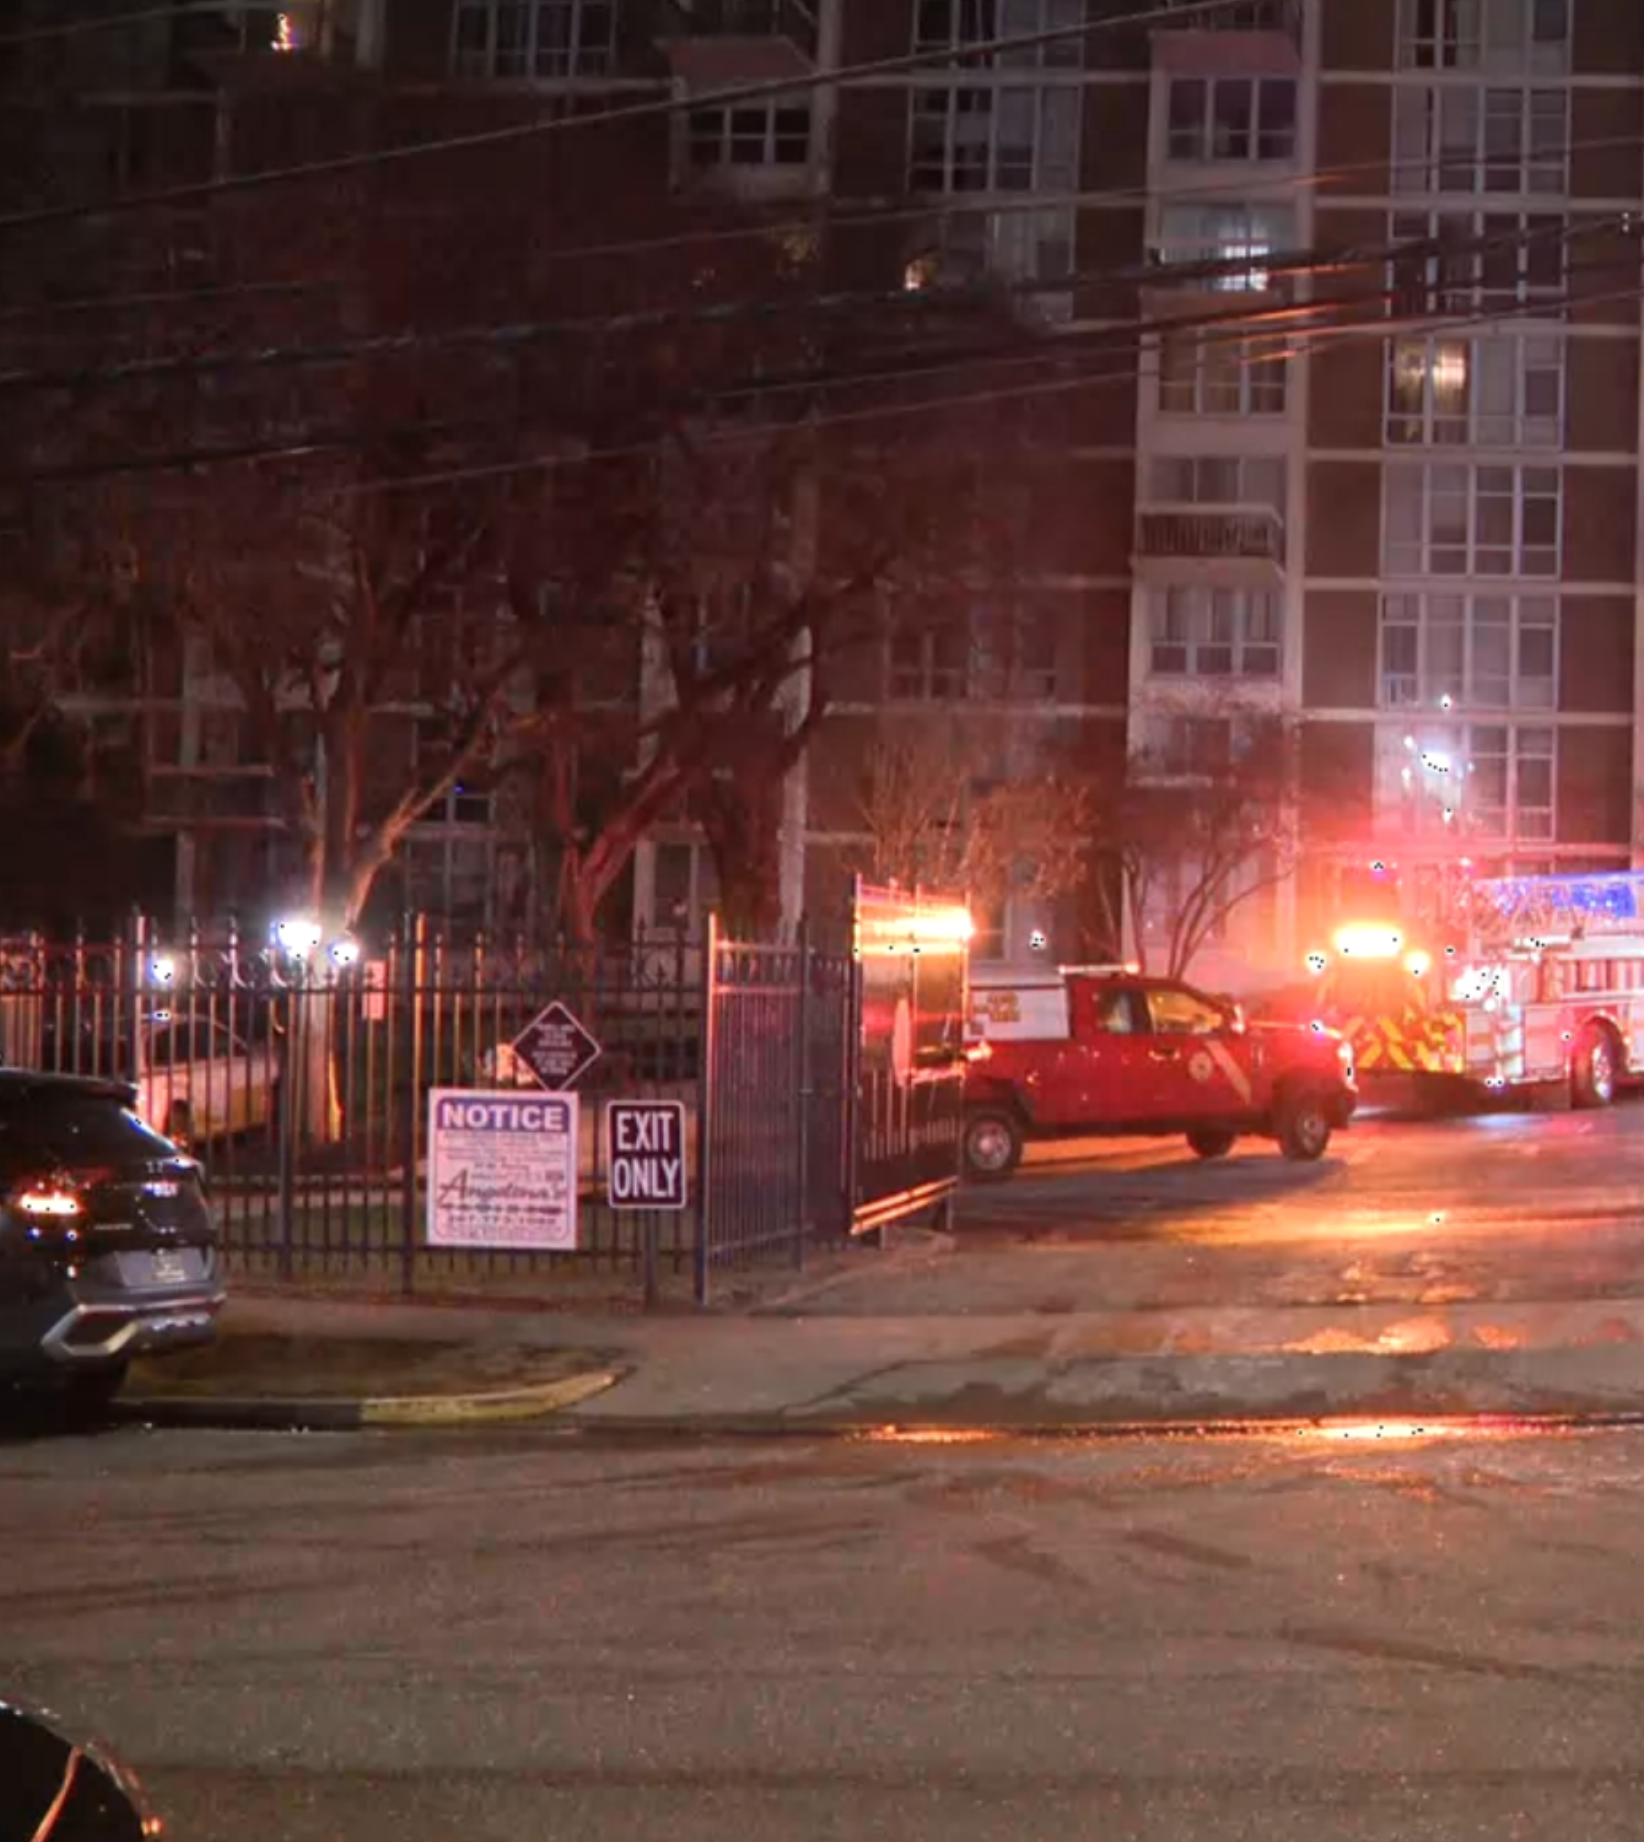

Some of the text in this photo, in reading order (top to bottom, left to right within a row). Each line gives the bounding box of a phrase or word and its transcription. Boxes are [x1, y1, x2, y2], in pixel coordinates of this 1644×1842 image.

[442, 1103, 564, 1130] NOTICE
[616, 1111, 674, 1151] EXIT
[614, 1158, 680, 1198] ONLY
